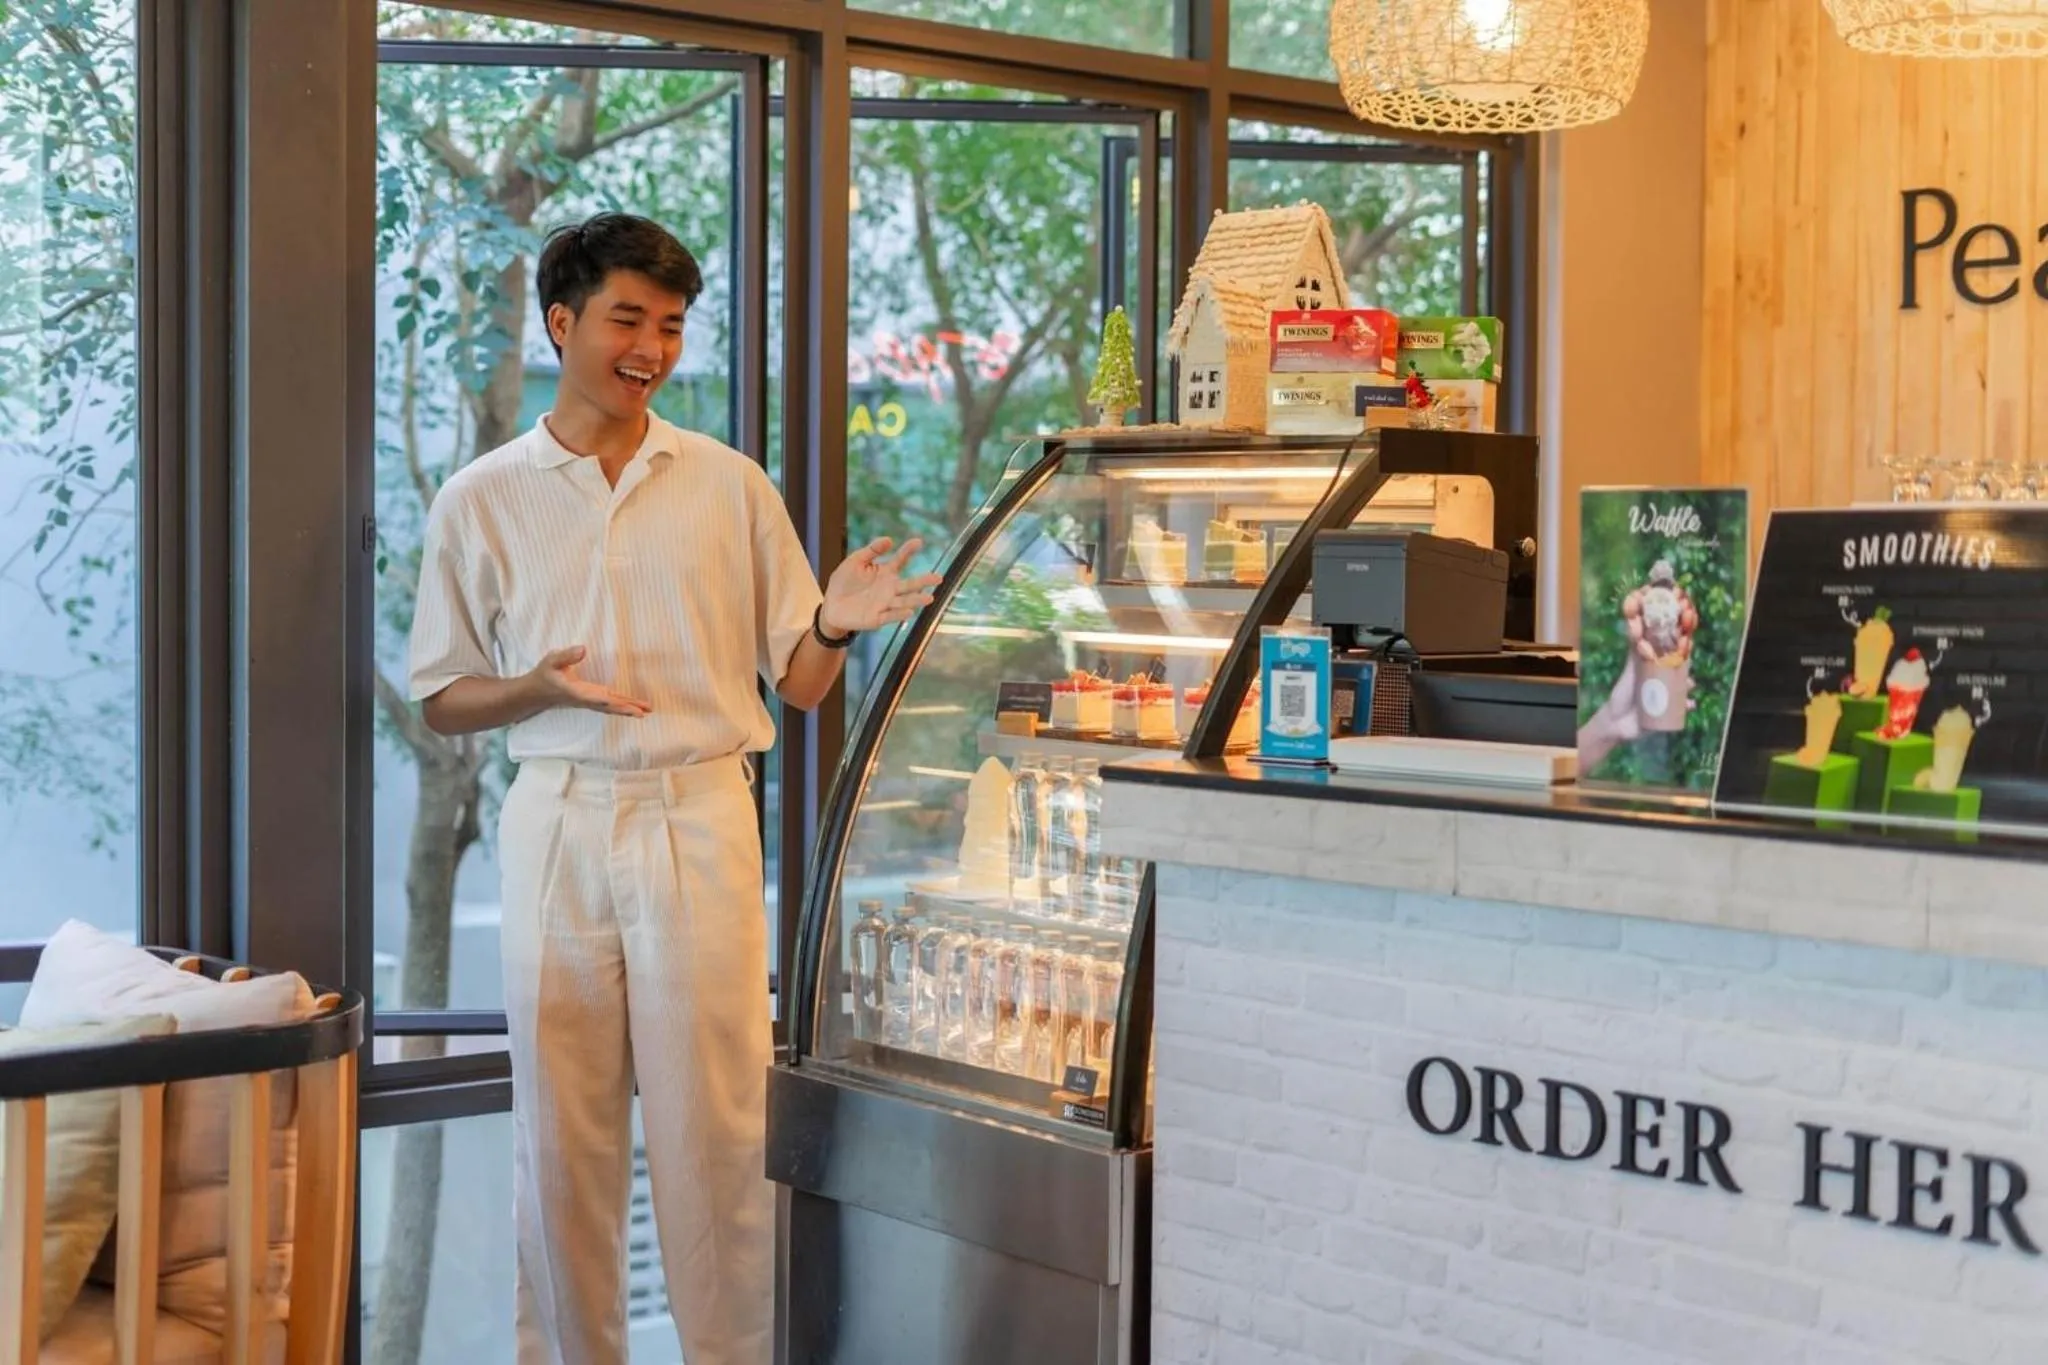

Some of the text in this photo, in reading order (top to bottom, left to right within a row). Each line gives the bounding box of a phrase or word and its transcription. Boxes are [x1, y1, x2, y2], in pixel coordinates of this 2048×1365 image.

[1899, 187, 2048, 309] Pe
[1283, 327, 1328, 337] TWININGS
[1278, 392, 1321, 401] TWININGS
[1628, 502, 1701, 537] Waffle
[1843, 531, 1997, 571] SMOOTHIES
[1406, 1056, 2042, 1257] ORDER HER
